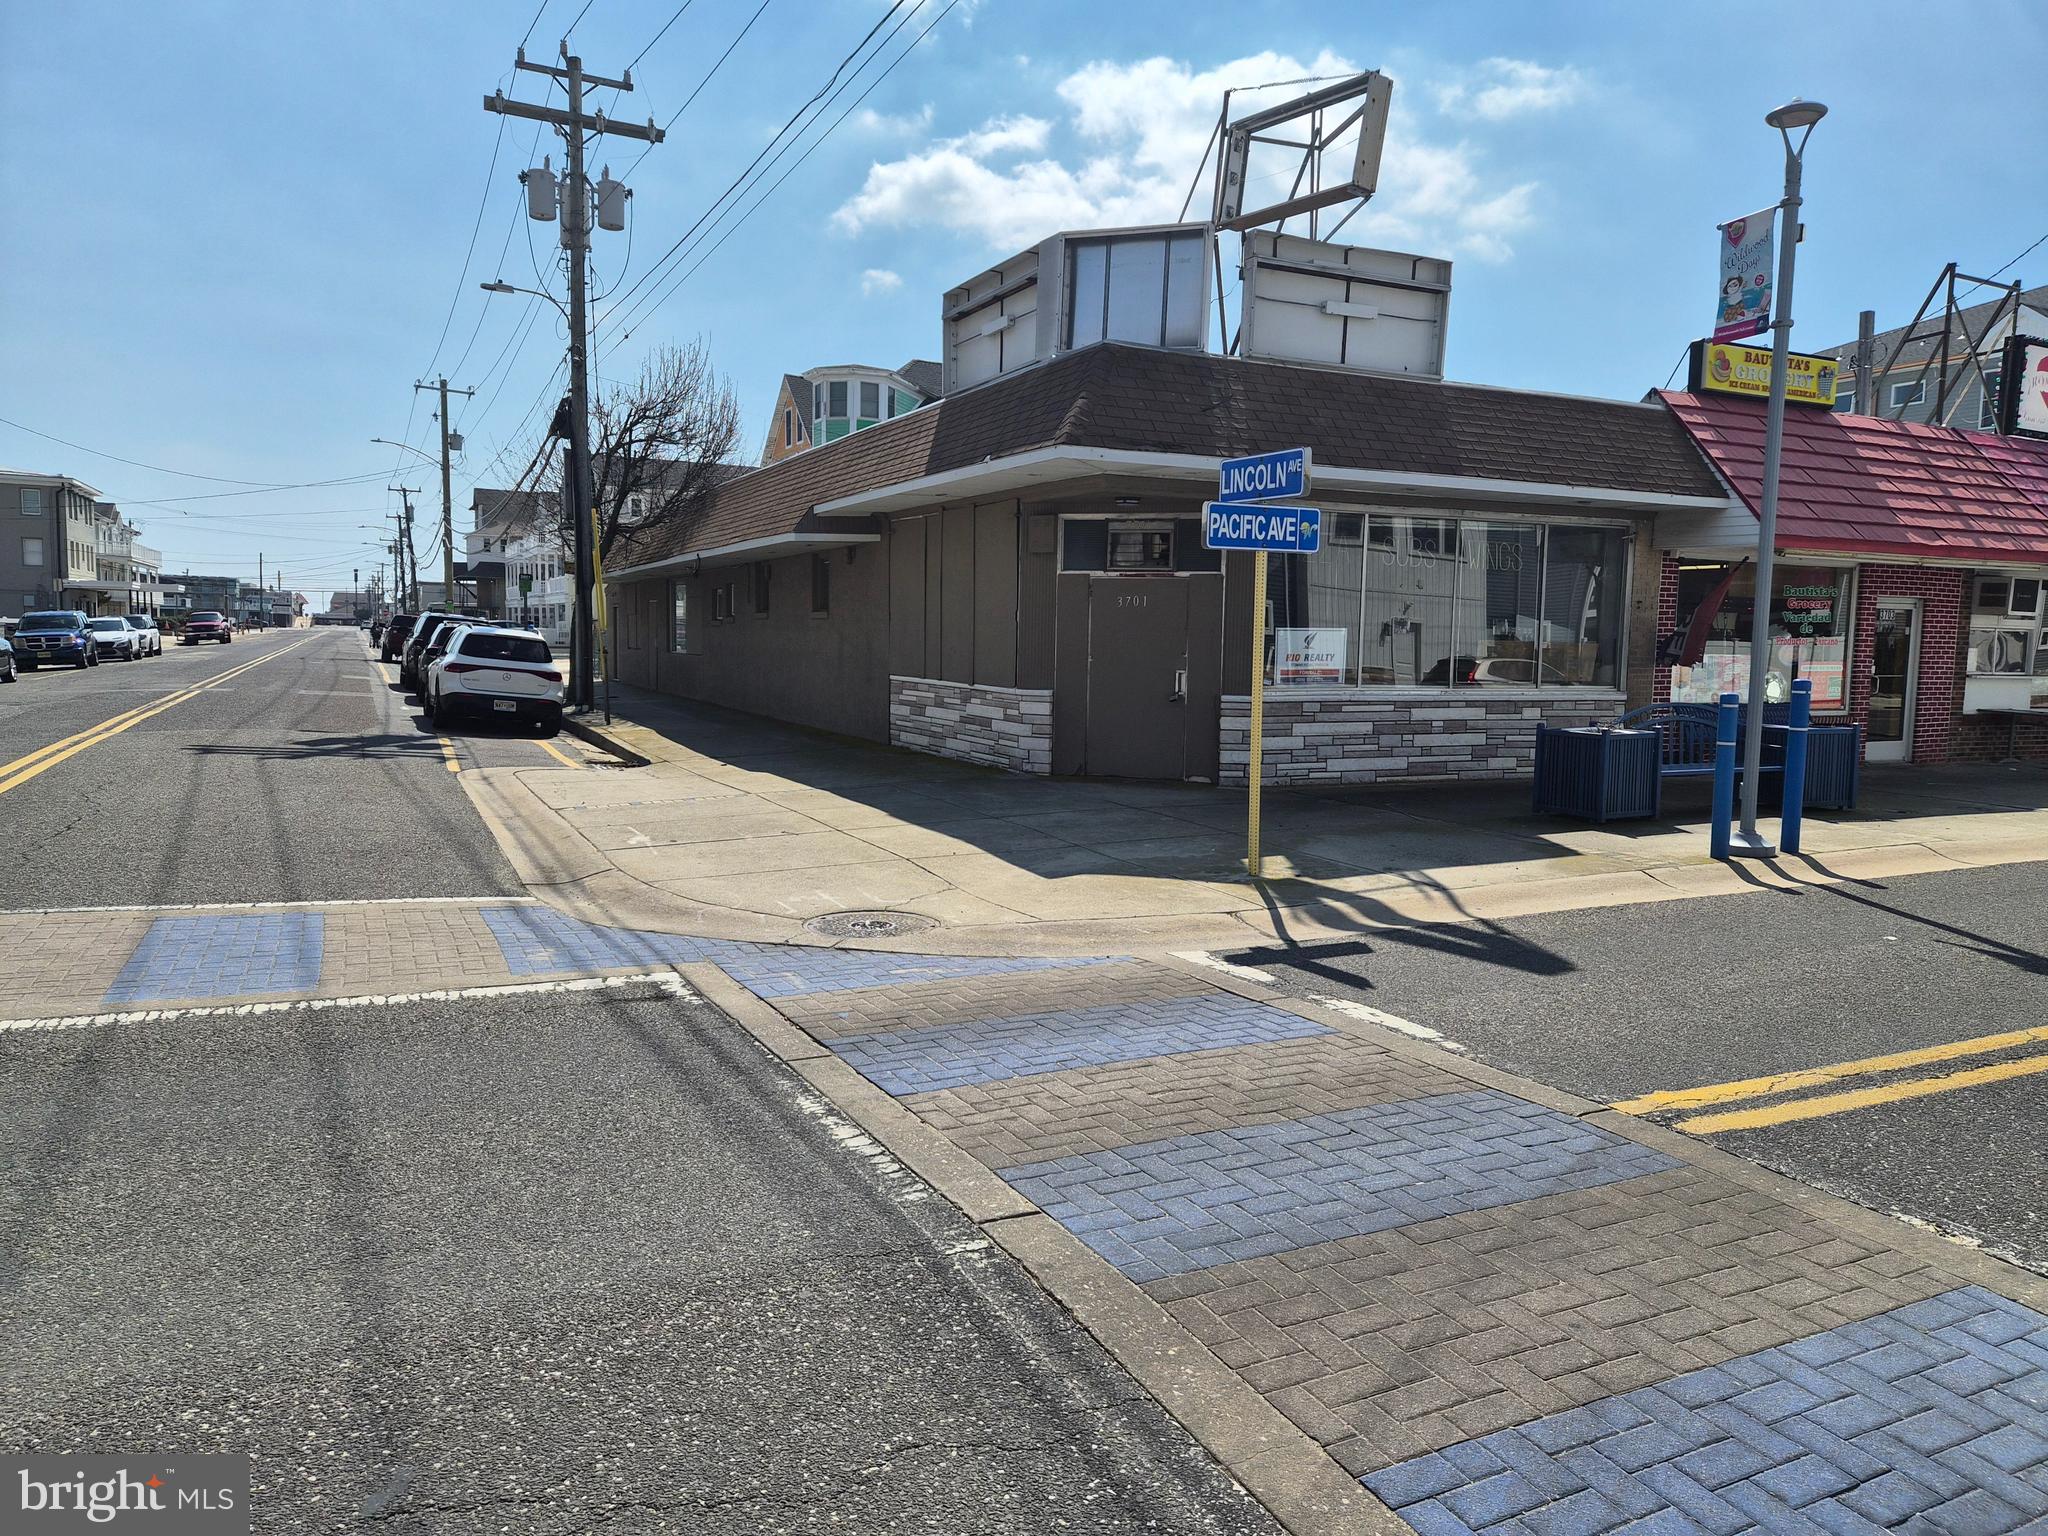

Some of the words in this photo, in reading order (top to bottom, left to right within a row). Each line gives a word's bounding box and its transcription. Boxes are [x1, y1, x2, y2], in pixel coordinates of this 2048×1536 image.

[1724, 228, 1769, 269] Wildwood
[1737, 255, 1761, 274] Days
[1744, 351, 1810, 371] BAUTA'S
[1735, 363, 1814, 389] GROERY
[1728, 380, 1739, 388] ICE
[1739, 381, 1760, 391] CREAM
[1221, 461, 1287, 495] LINCOLN
[1287, 458, 1302, 473] AVE
[1209, 512, 1266, 540] PACIFIC
[1266, 516, 1297, 542] AVE
[1382, 536, 1436, 568] SUBS
[1467, 542, 1523, 572] WINGS
[1783, 584, 1839, 597] Bautista's
[1116, 595, 1148, 608] 3701
[1787, 597, 1832, 609] Grocery
[1782, 611, 1832, 623] Variedad
[1799, 622, 1814, 634] de
[1303, 653, 1335, 662] REALTY
